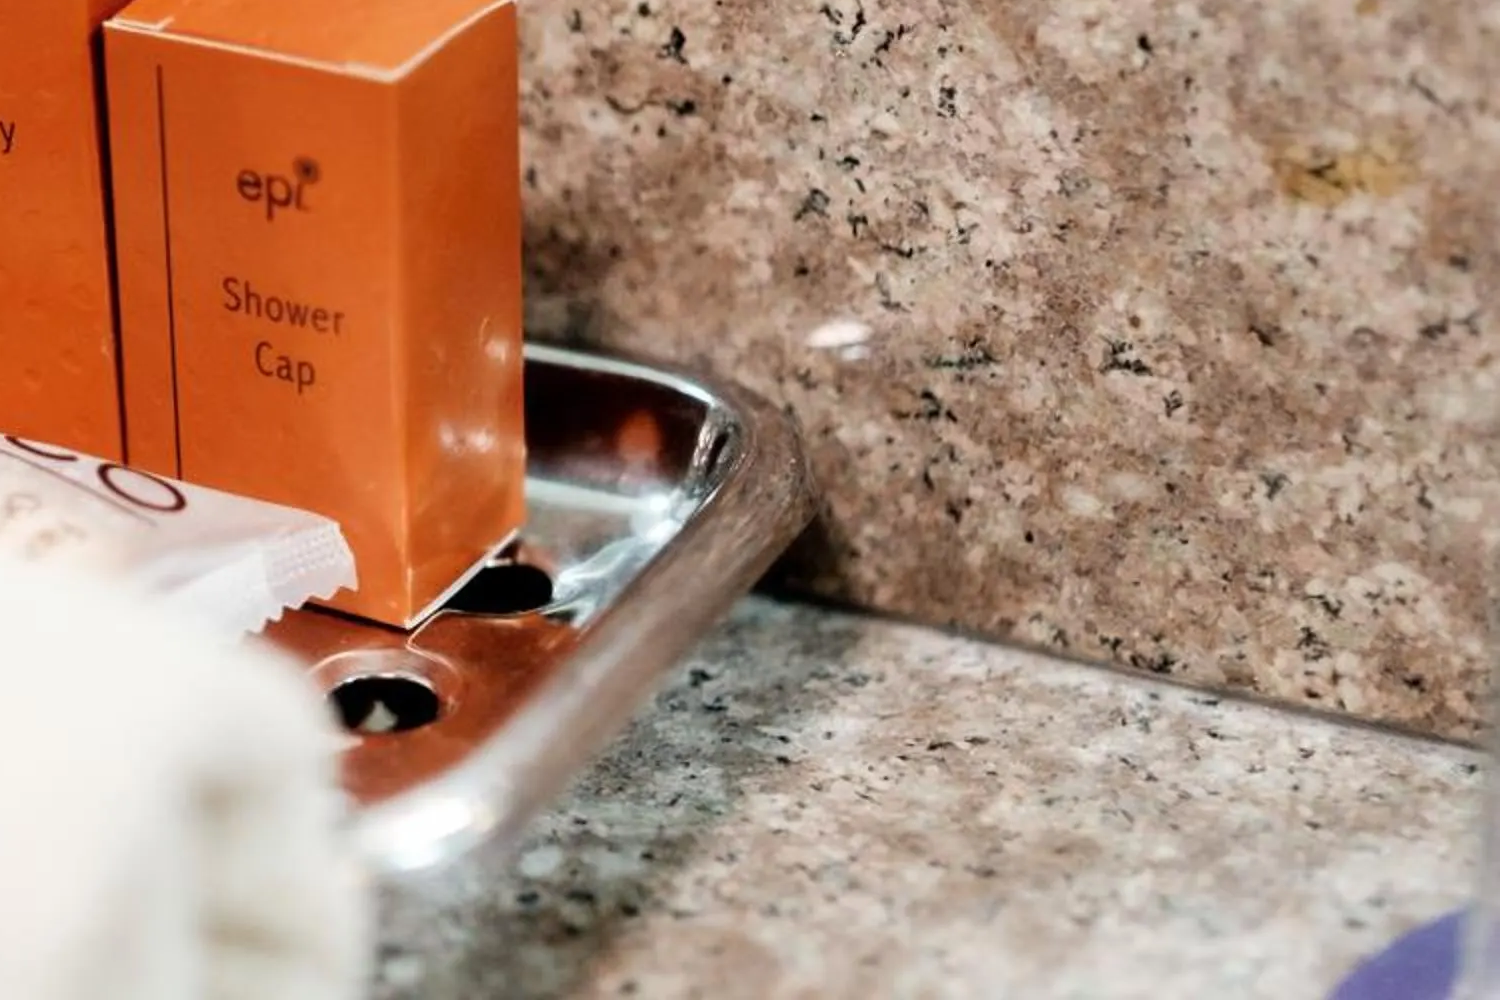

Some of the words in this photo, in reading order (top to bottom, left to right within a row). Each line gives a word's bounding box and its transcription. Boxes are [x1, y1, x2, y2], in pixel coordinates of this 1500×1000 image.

[236, 156, 322, 223] epi
[222, 276, 346, 336] Shower
[255, 340, 317, 396] Cap
